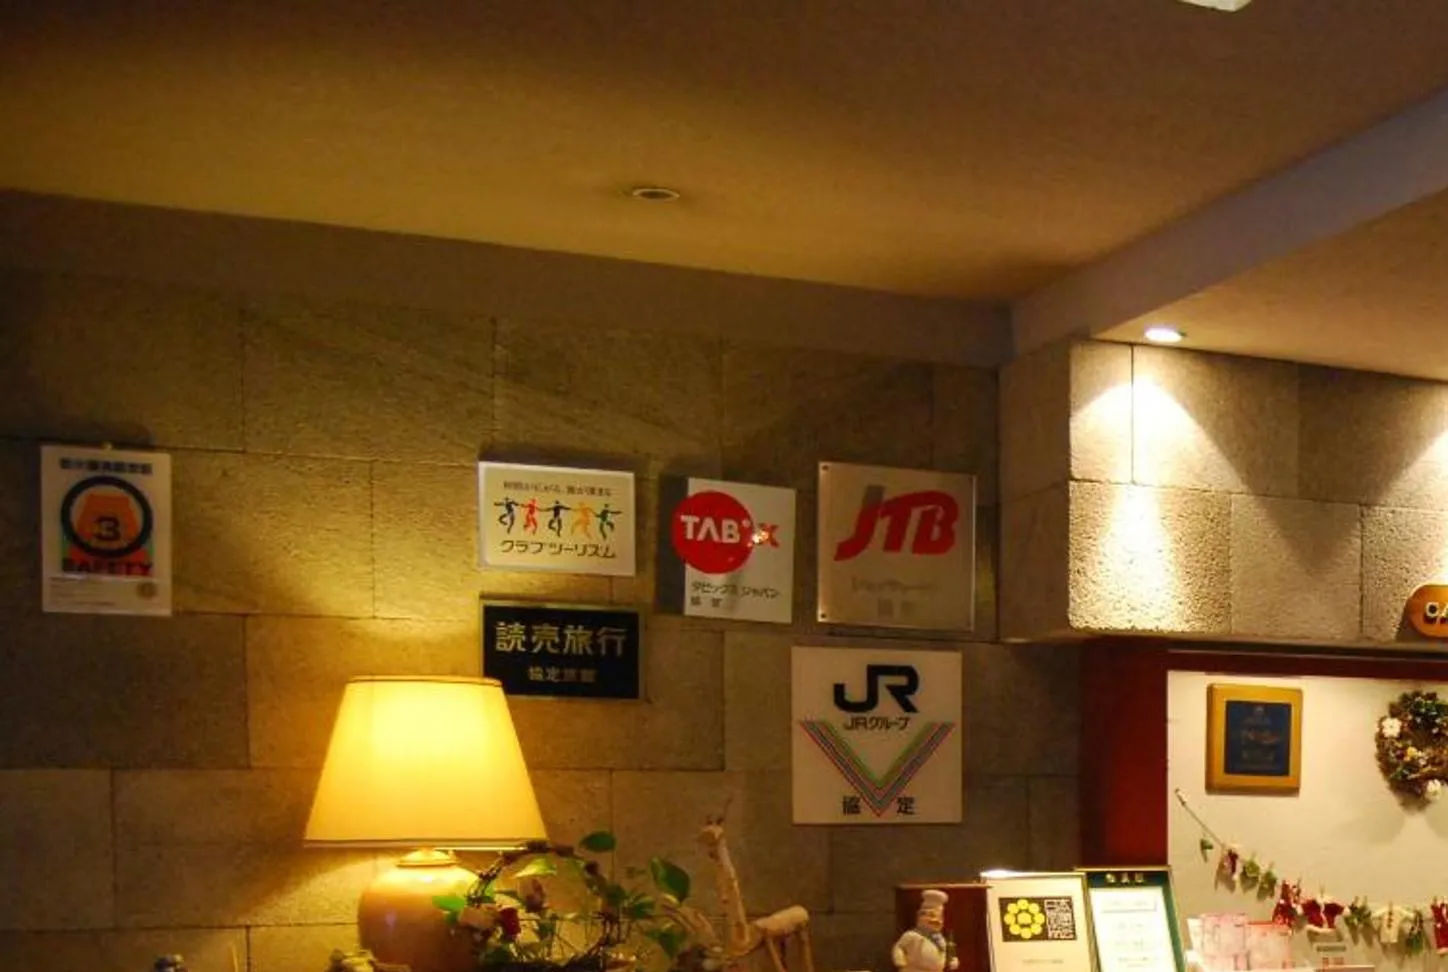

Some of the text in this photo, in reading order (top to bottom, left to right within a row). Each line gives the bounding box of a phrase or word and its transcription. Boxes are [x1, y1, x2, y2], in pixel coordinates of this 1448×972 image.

[92, 515, 121, 542] 3
[833, 484, 958, 562] JTB
[494, 620, 629, 658] 読売旅行
[833, 664, 920, 713] JR
[843, 715, 911, 731] JRグループ
